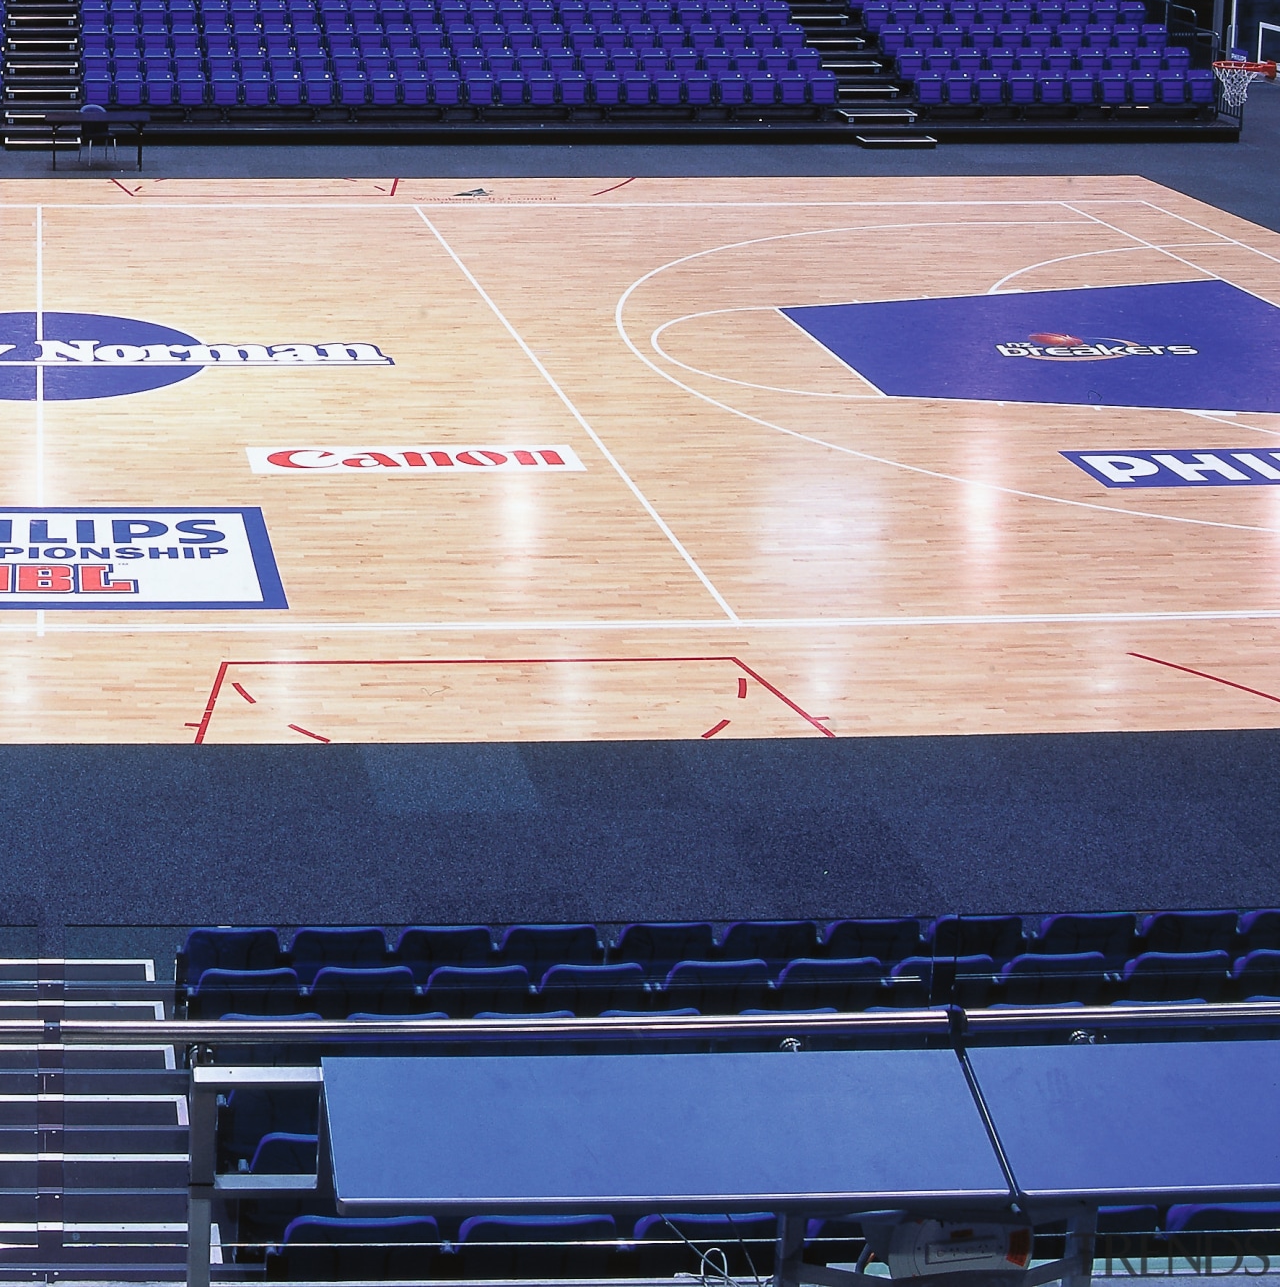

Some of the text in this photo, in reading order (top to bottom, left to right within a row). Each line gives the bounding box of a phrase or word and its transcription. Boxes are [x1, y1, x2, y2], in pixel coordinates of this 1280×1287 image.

[33, 338, 388, 364] Norman
[995, 343, 1199, 357] breakers
[266, 448, 566, 469] Canon
[1079, 452, 1280, 483] PHI
